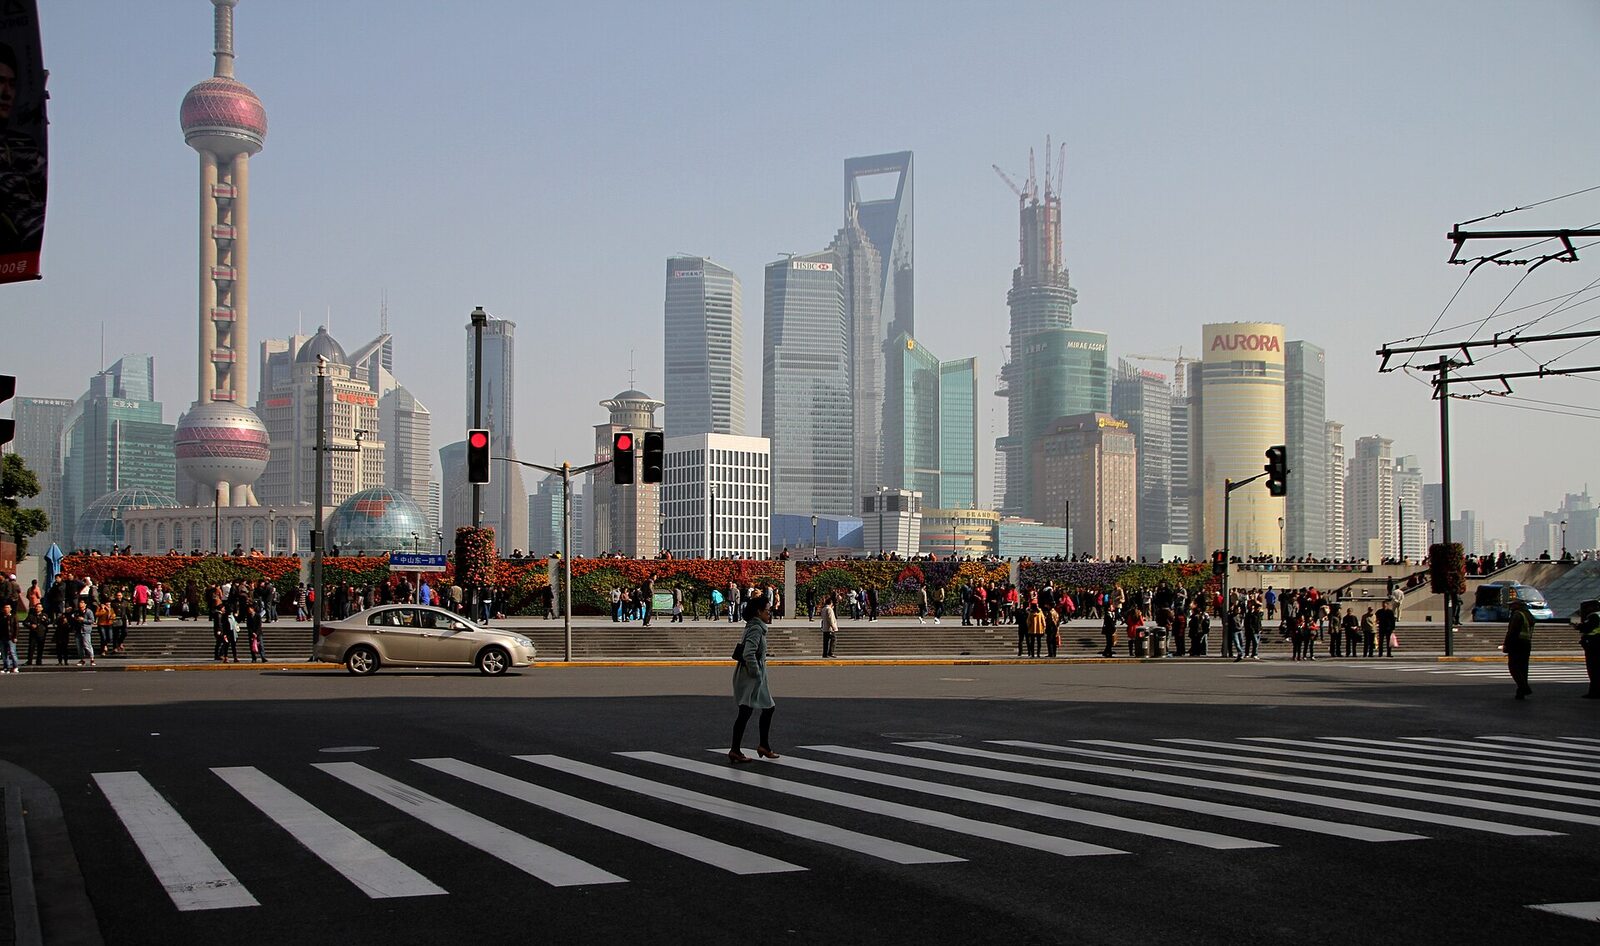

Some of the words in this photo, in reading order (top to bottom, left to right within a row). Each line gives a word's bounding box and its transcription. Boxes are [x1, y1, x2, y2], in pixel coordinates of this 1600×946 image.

[0, 260, 28, 274] 00号
[796, 262, 817, 270] HSBC
[1211, 334, 1280, 352] AURORA
